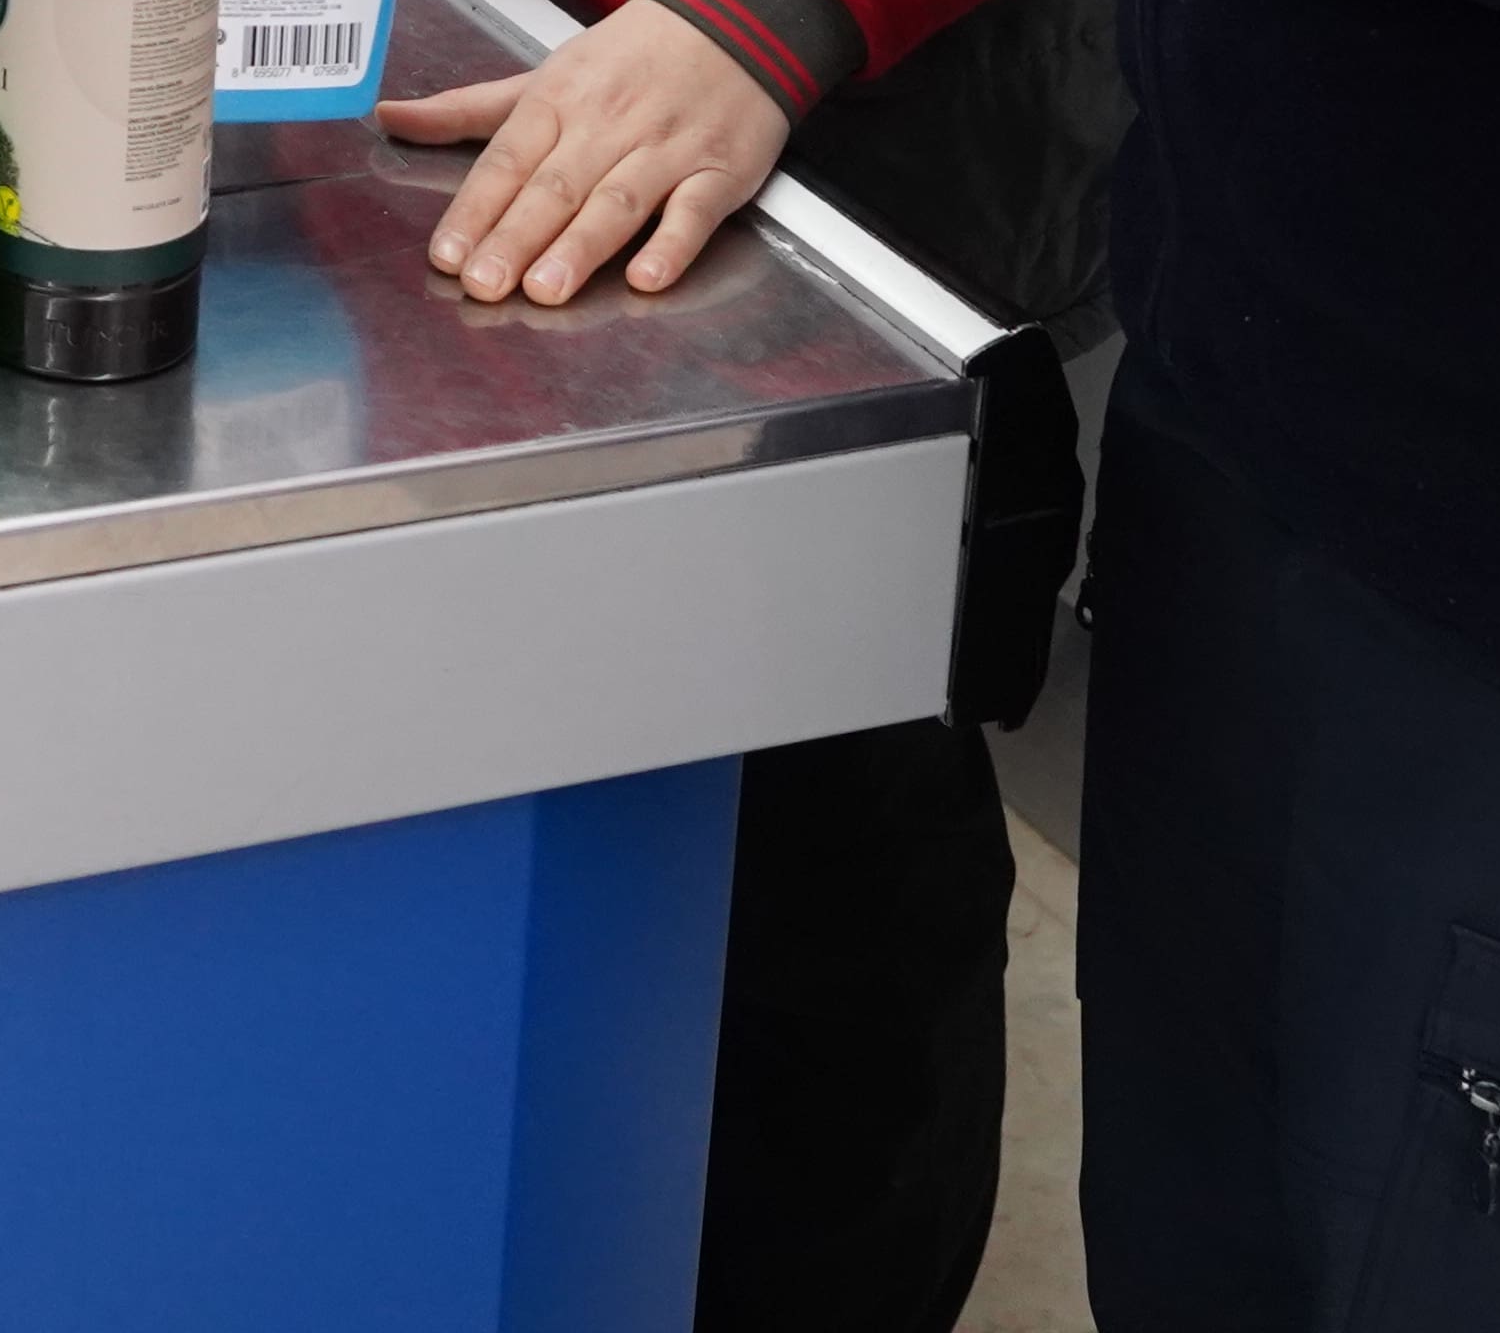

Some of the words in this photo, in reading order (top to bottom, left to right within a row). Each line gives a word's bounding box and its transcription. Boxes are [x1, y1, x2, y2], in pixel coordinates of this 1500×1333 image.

[231, 68, 239, 78] 8
[253, 68, 292, 79] 695077
[313, 65, 349, 77] 079589
